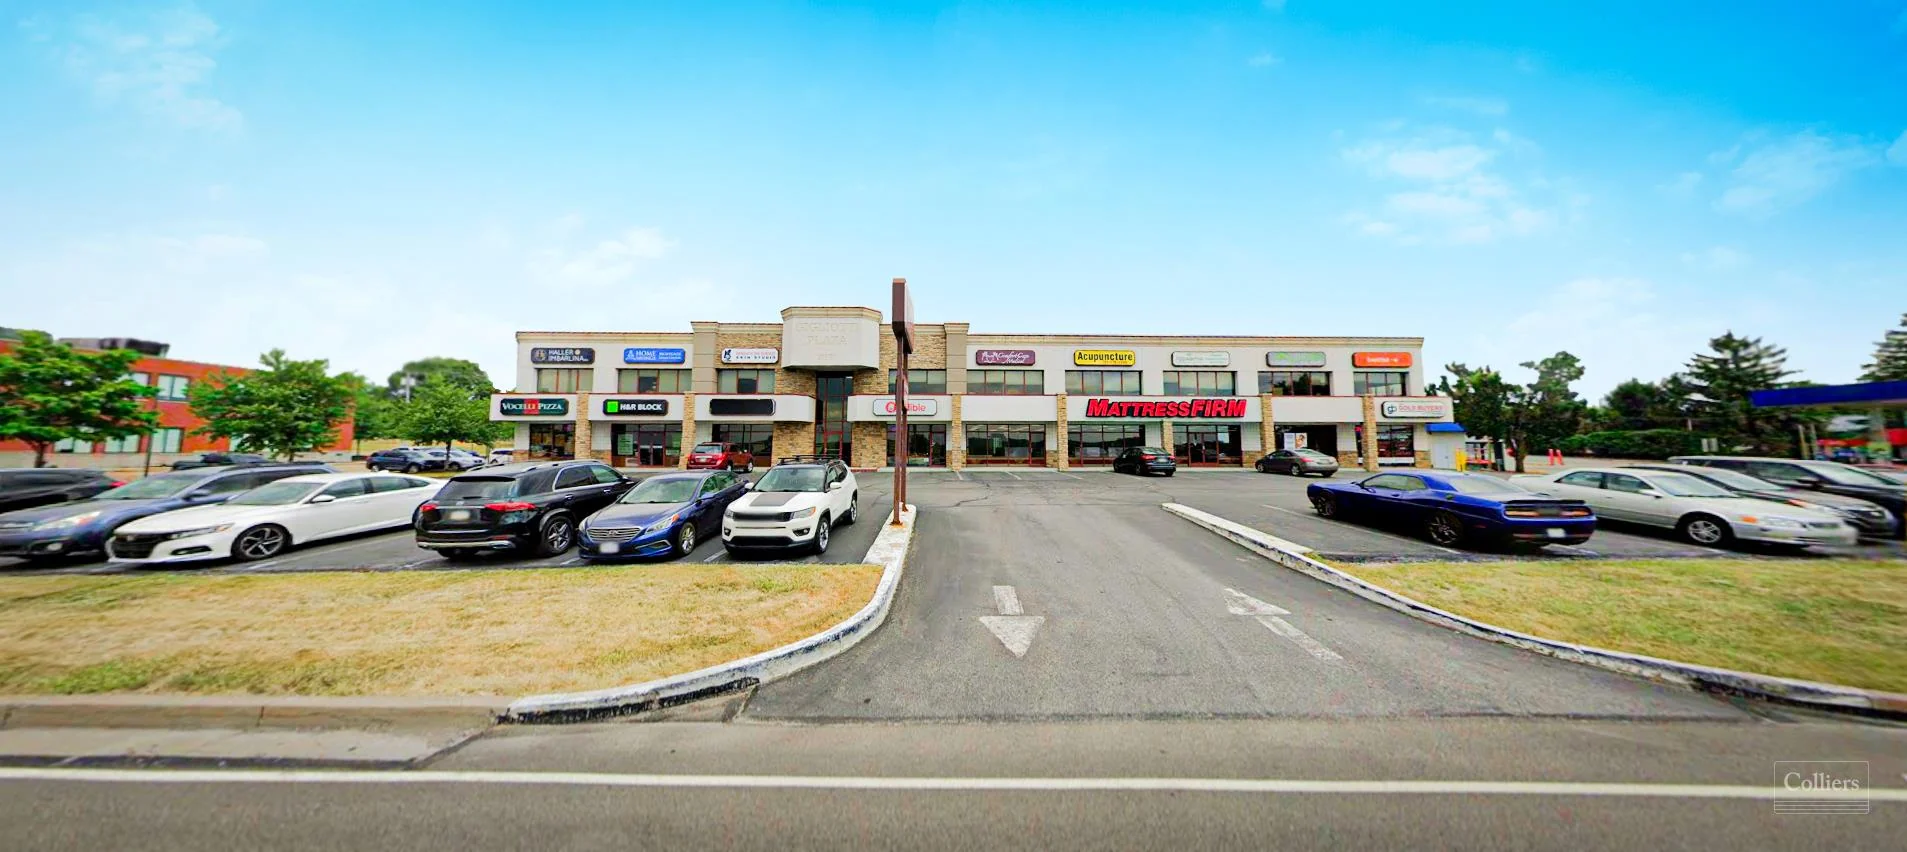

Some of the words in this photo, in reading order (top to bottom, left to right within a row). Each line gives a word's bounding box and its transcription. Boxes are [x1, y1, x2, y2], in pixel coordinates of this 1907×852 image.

[1077, 351, 1133, 363] Acupuncture
[538, 402, 563, 410] PIZZA
[620, 403, 637, 411] H&R
[637, 403, 663, 411] BLOCK
